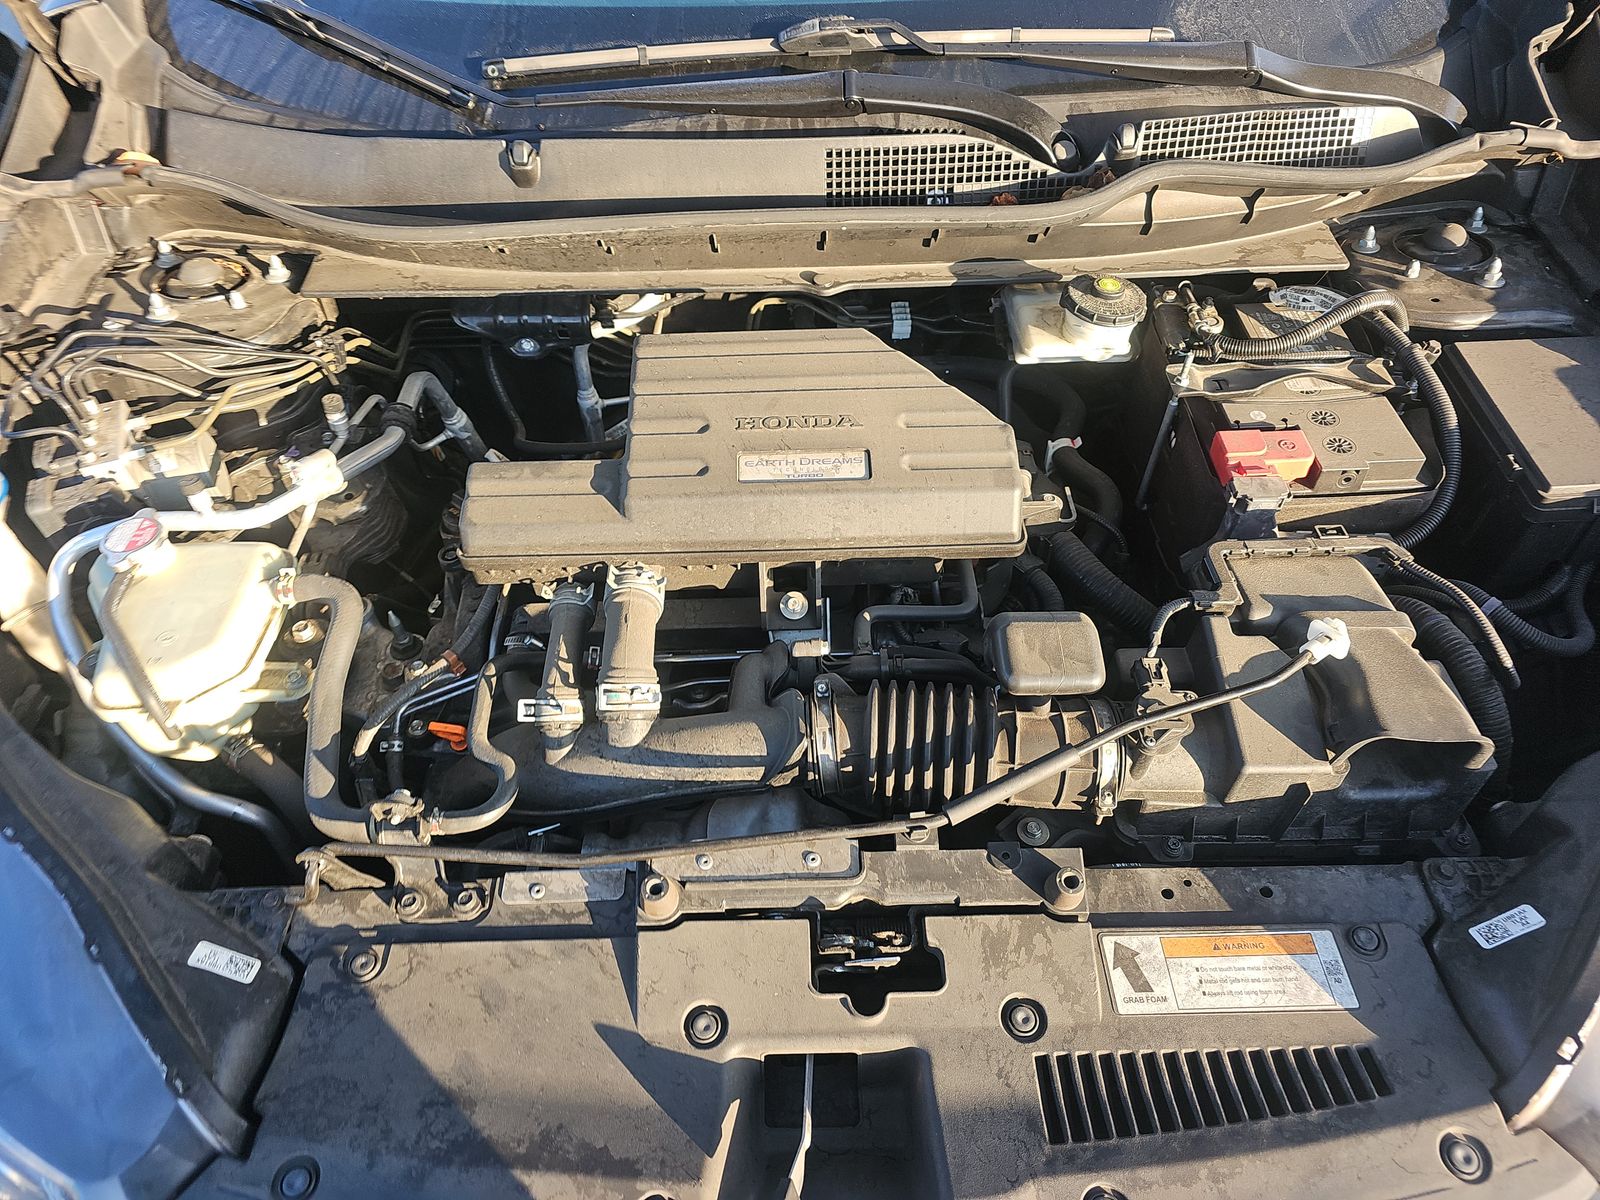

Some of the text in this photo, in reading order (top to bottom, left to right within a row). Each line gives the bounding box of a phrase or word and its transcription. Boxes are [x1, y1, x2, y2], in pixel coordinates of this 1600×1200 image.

[734, 414, 864, 430] HONDA
[744, 456, 863, 467] EARTH DREAMS
[1223, 942, 1266, 950] WARNING
[1123, 995, 1168, 1004] GRAB FOAM
